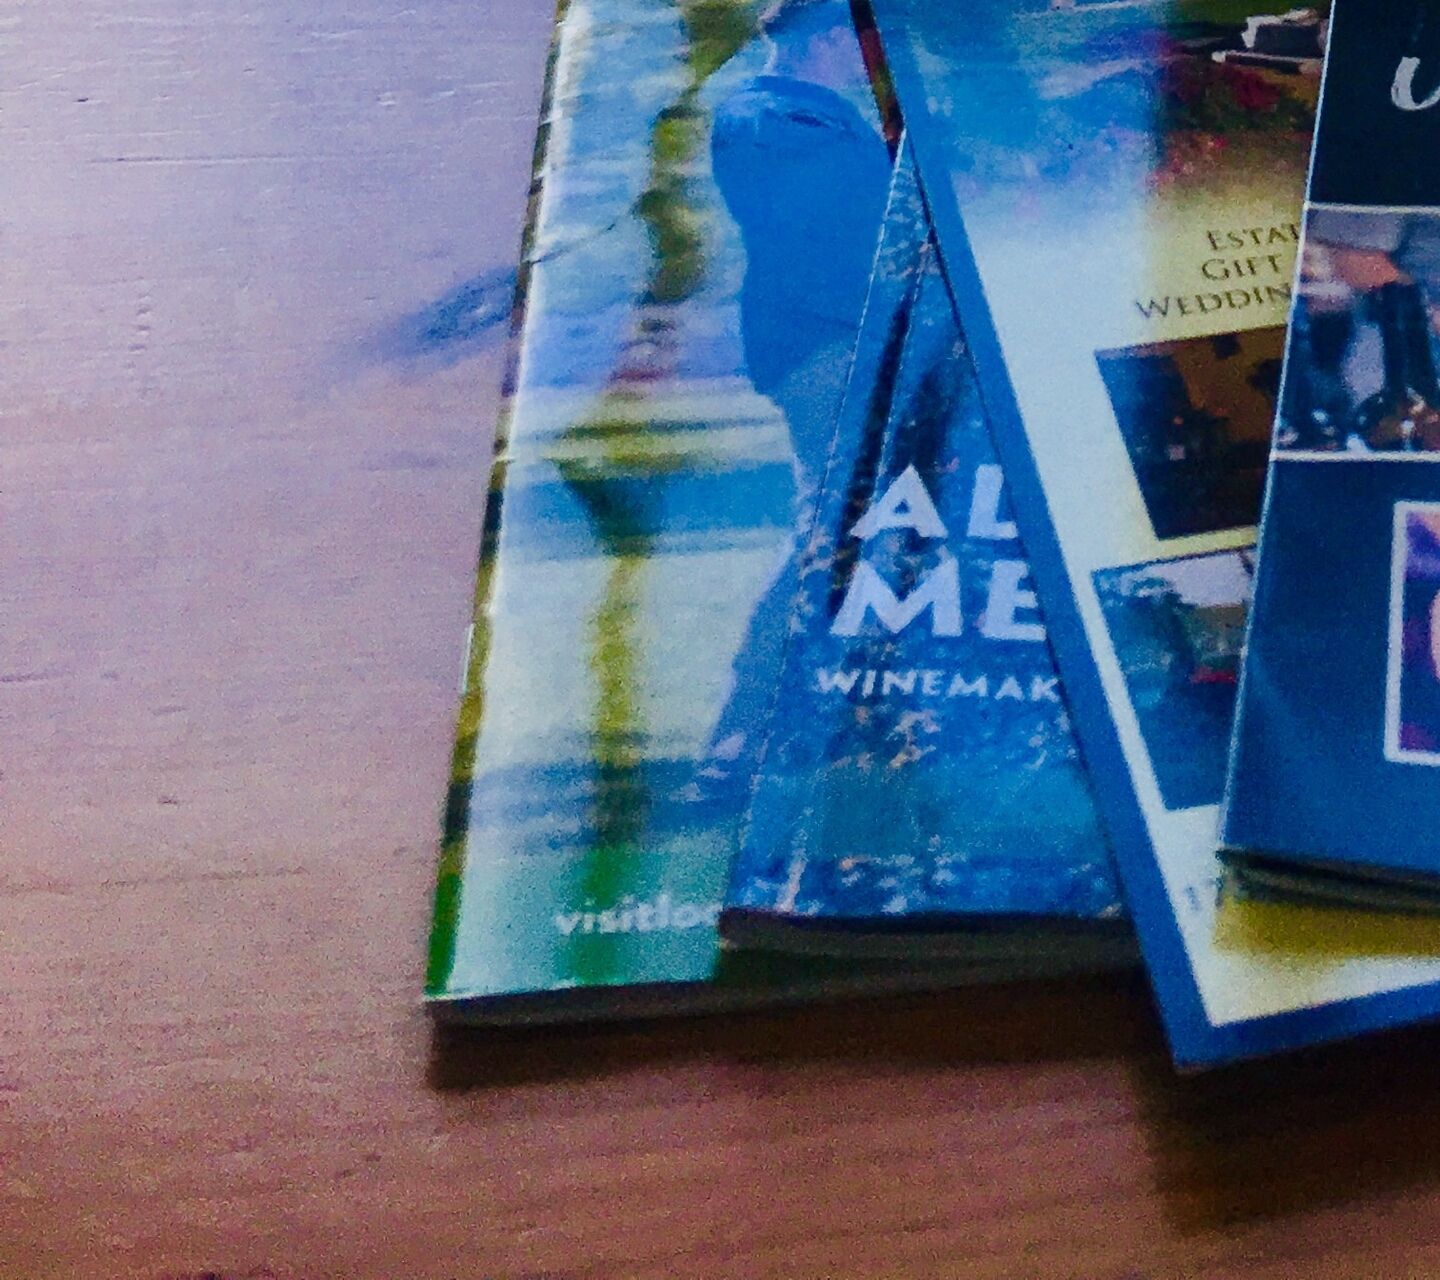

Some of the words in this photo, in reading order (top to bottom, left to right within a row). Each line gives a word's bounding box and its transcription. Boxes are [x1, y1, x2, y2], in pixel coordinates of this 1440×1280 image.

[1201, 254, 1282, 281] GIFT
[849, 462, 1019, 541] AL
[828, 544, 1048, 642] ME
[813, 667, 1062, 702] WINEMAK
